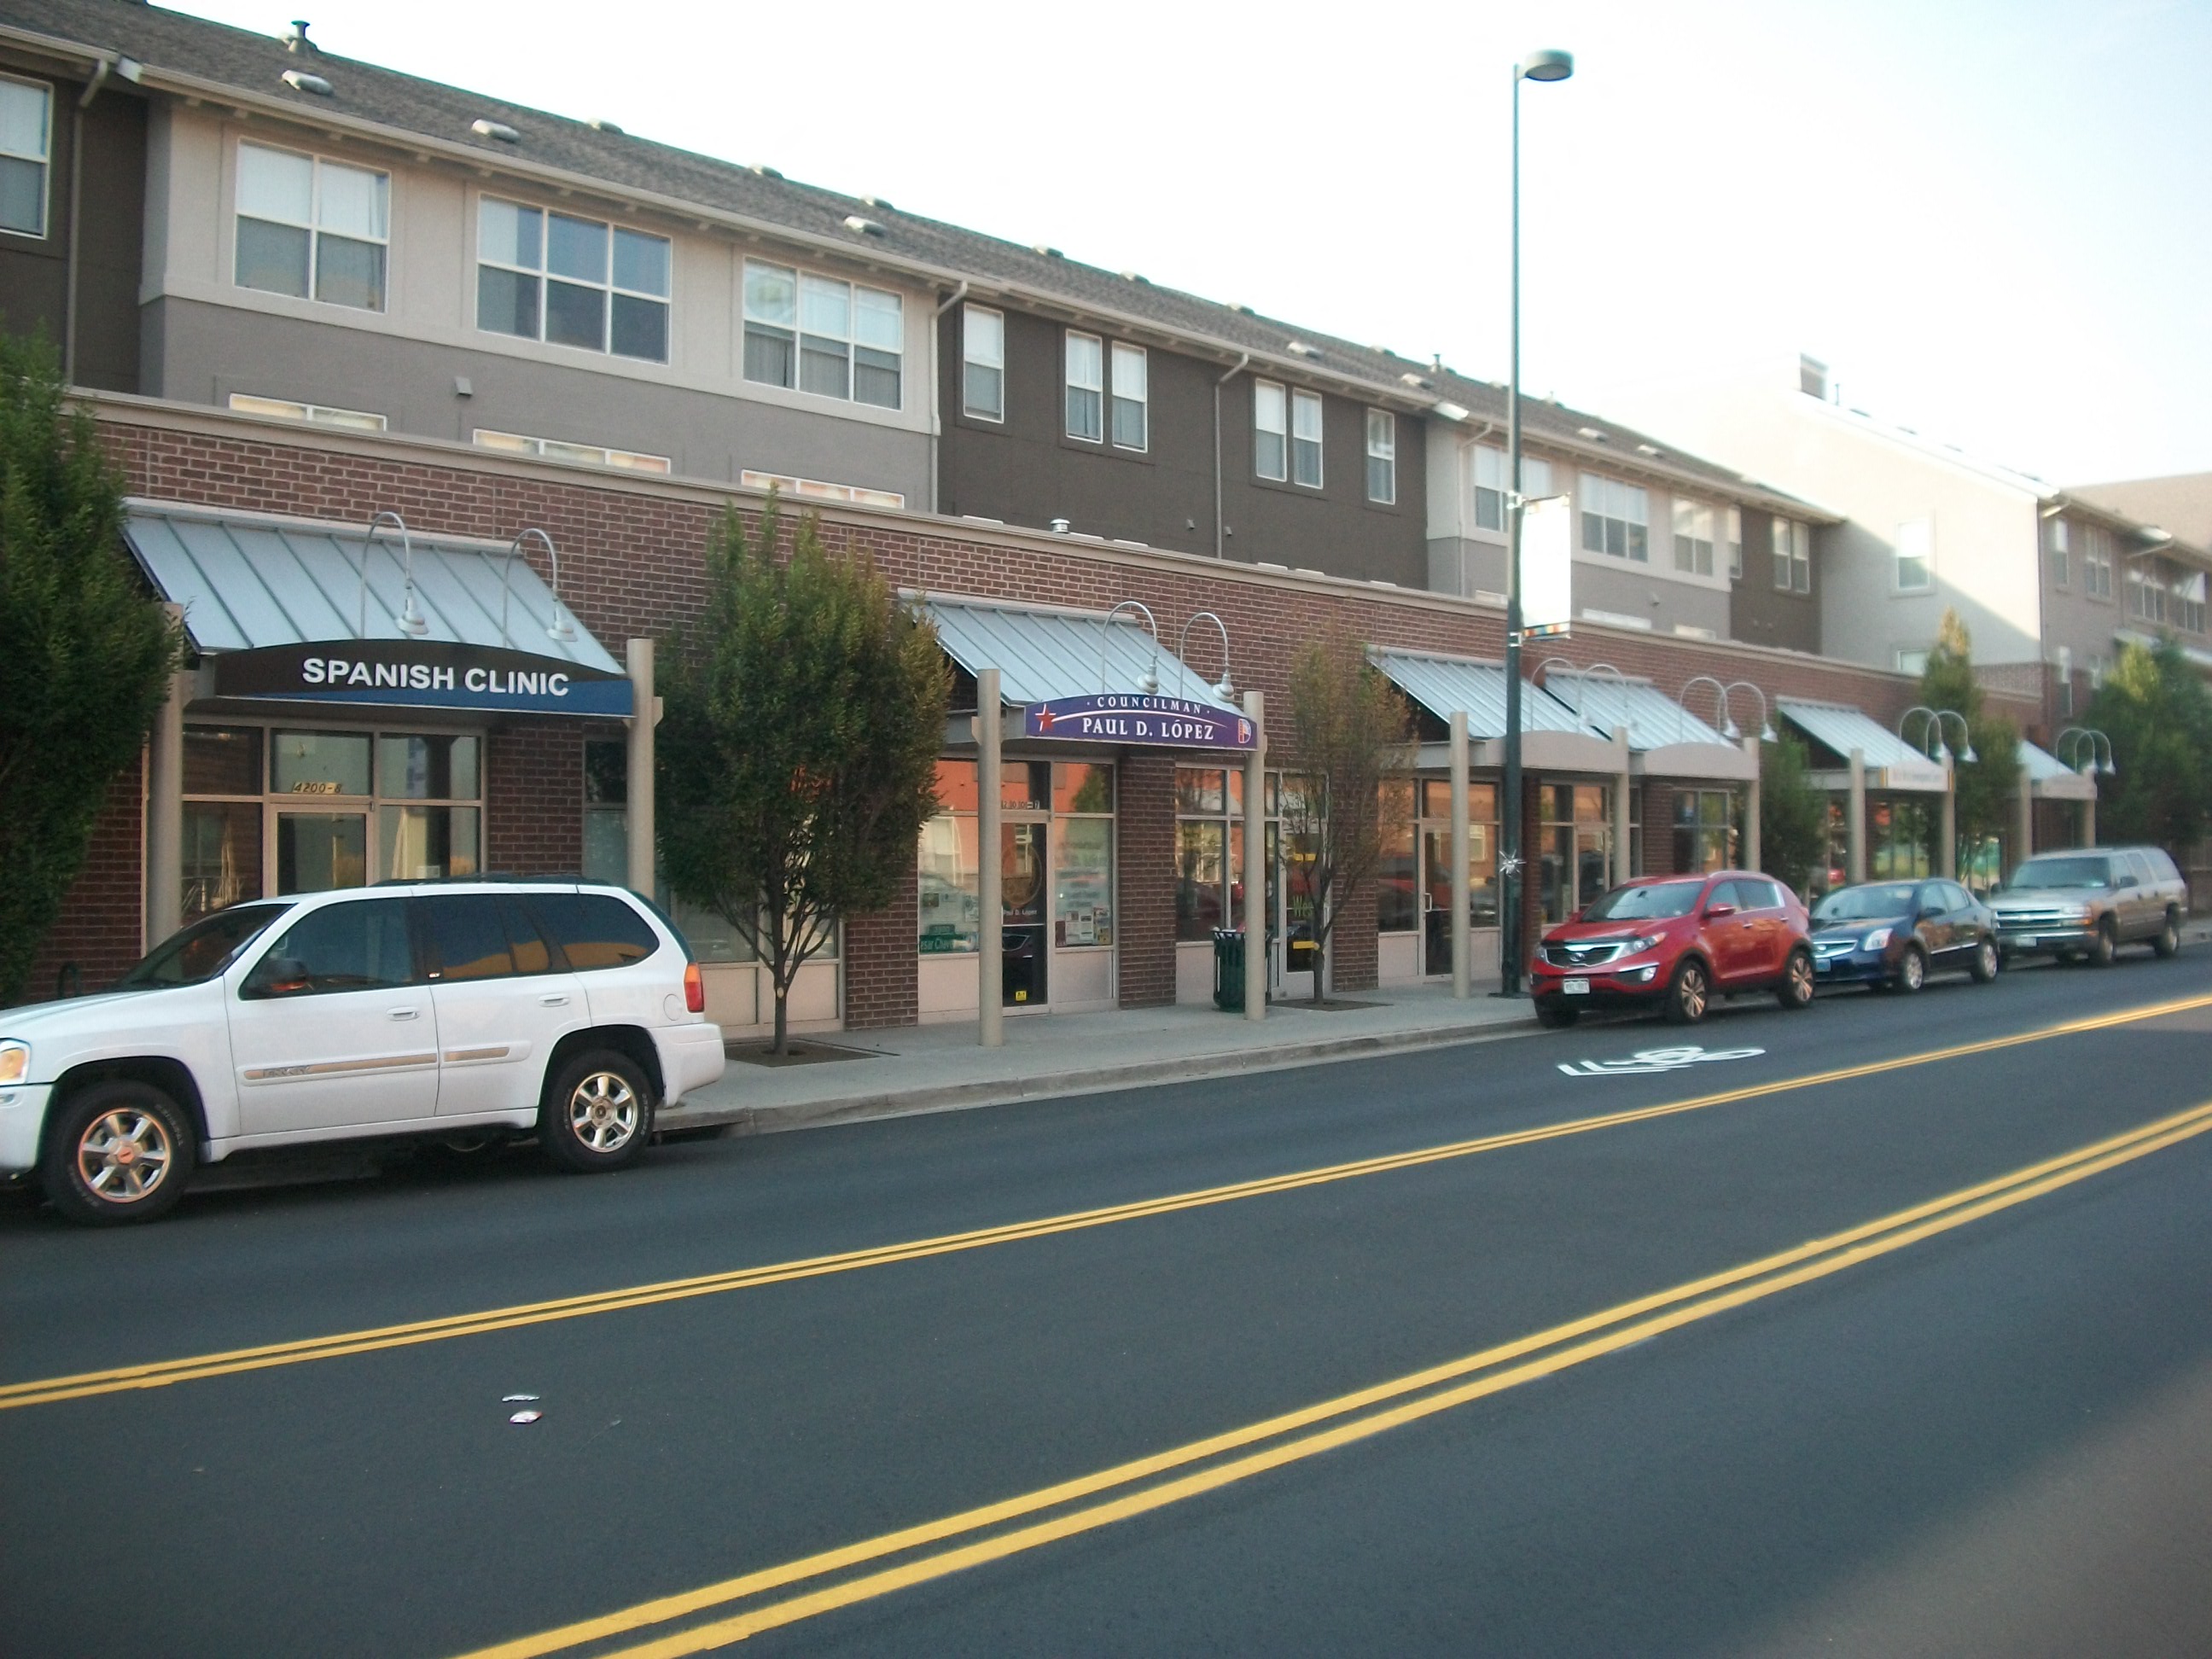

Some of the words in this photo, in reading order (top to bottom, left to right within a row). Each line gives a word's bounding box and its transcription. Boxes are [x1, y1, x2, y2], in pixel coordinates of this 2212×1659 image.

[303, 658, 454, 690] SPANISH
[464, 668, 569, 696] CLINIC
[1097, 696, 1201, 714] COUNCILMAN
[1082, 717, 1127, 736] PAUL
[1136, 720, 1153, 736] D.
[1161, 719, 1214, 740] LÓPEZ
